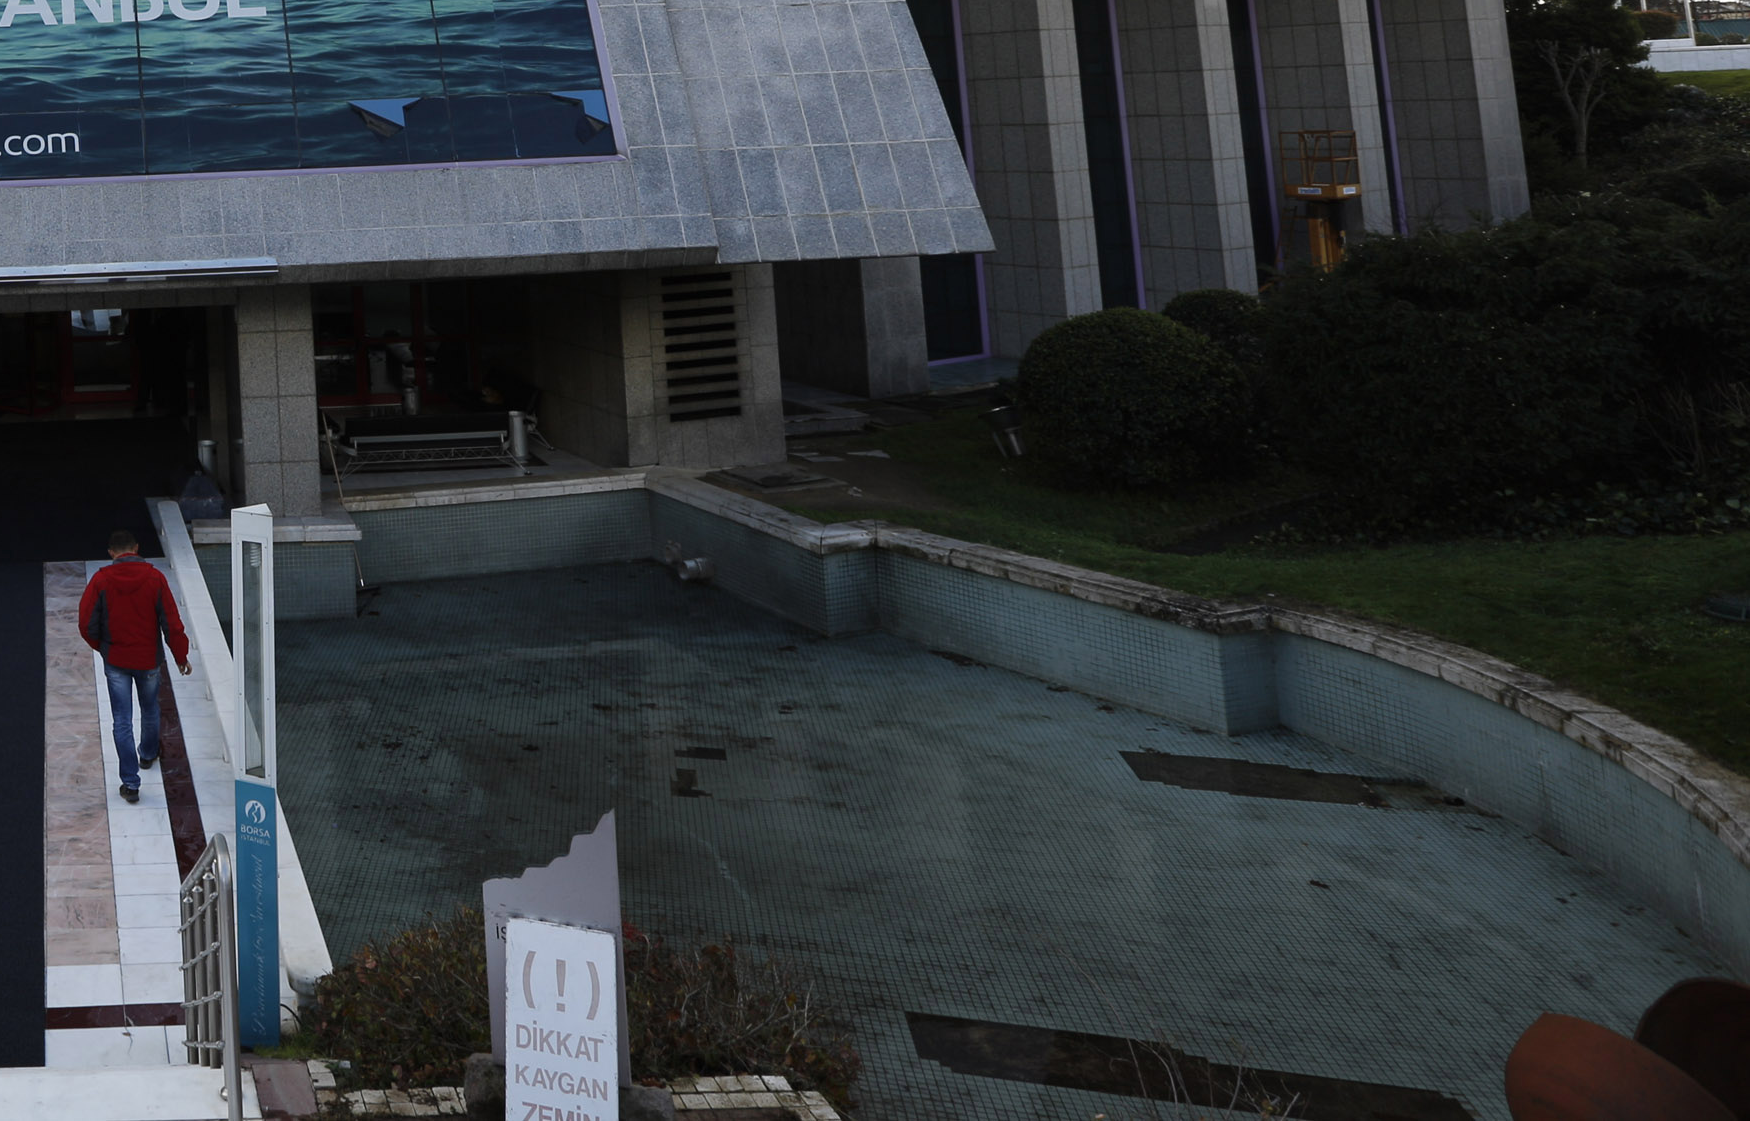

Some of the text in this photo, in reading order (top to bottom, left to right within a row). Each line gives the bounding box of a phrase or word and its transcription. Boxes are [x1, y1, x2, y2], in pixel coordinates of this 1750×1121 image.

[240, 824, 270, 838] BORSA
[515, 1020, 604, 1063] DİKKAT
[515, 1063, 608, 1102] KAYGAN
[521, 1101, 600, 1121] ZEMİ
